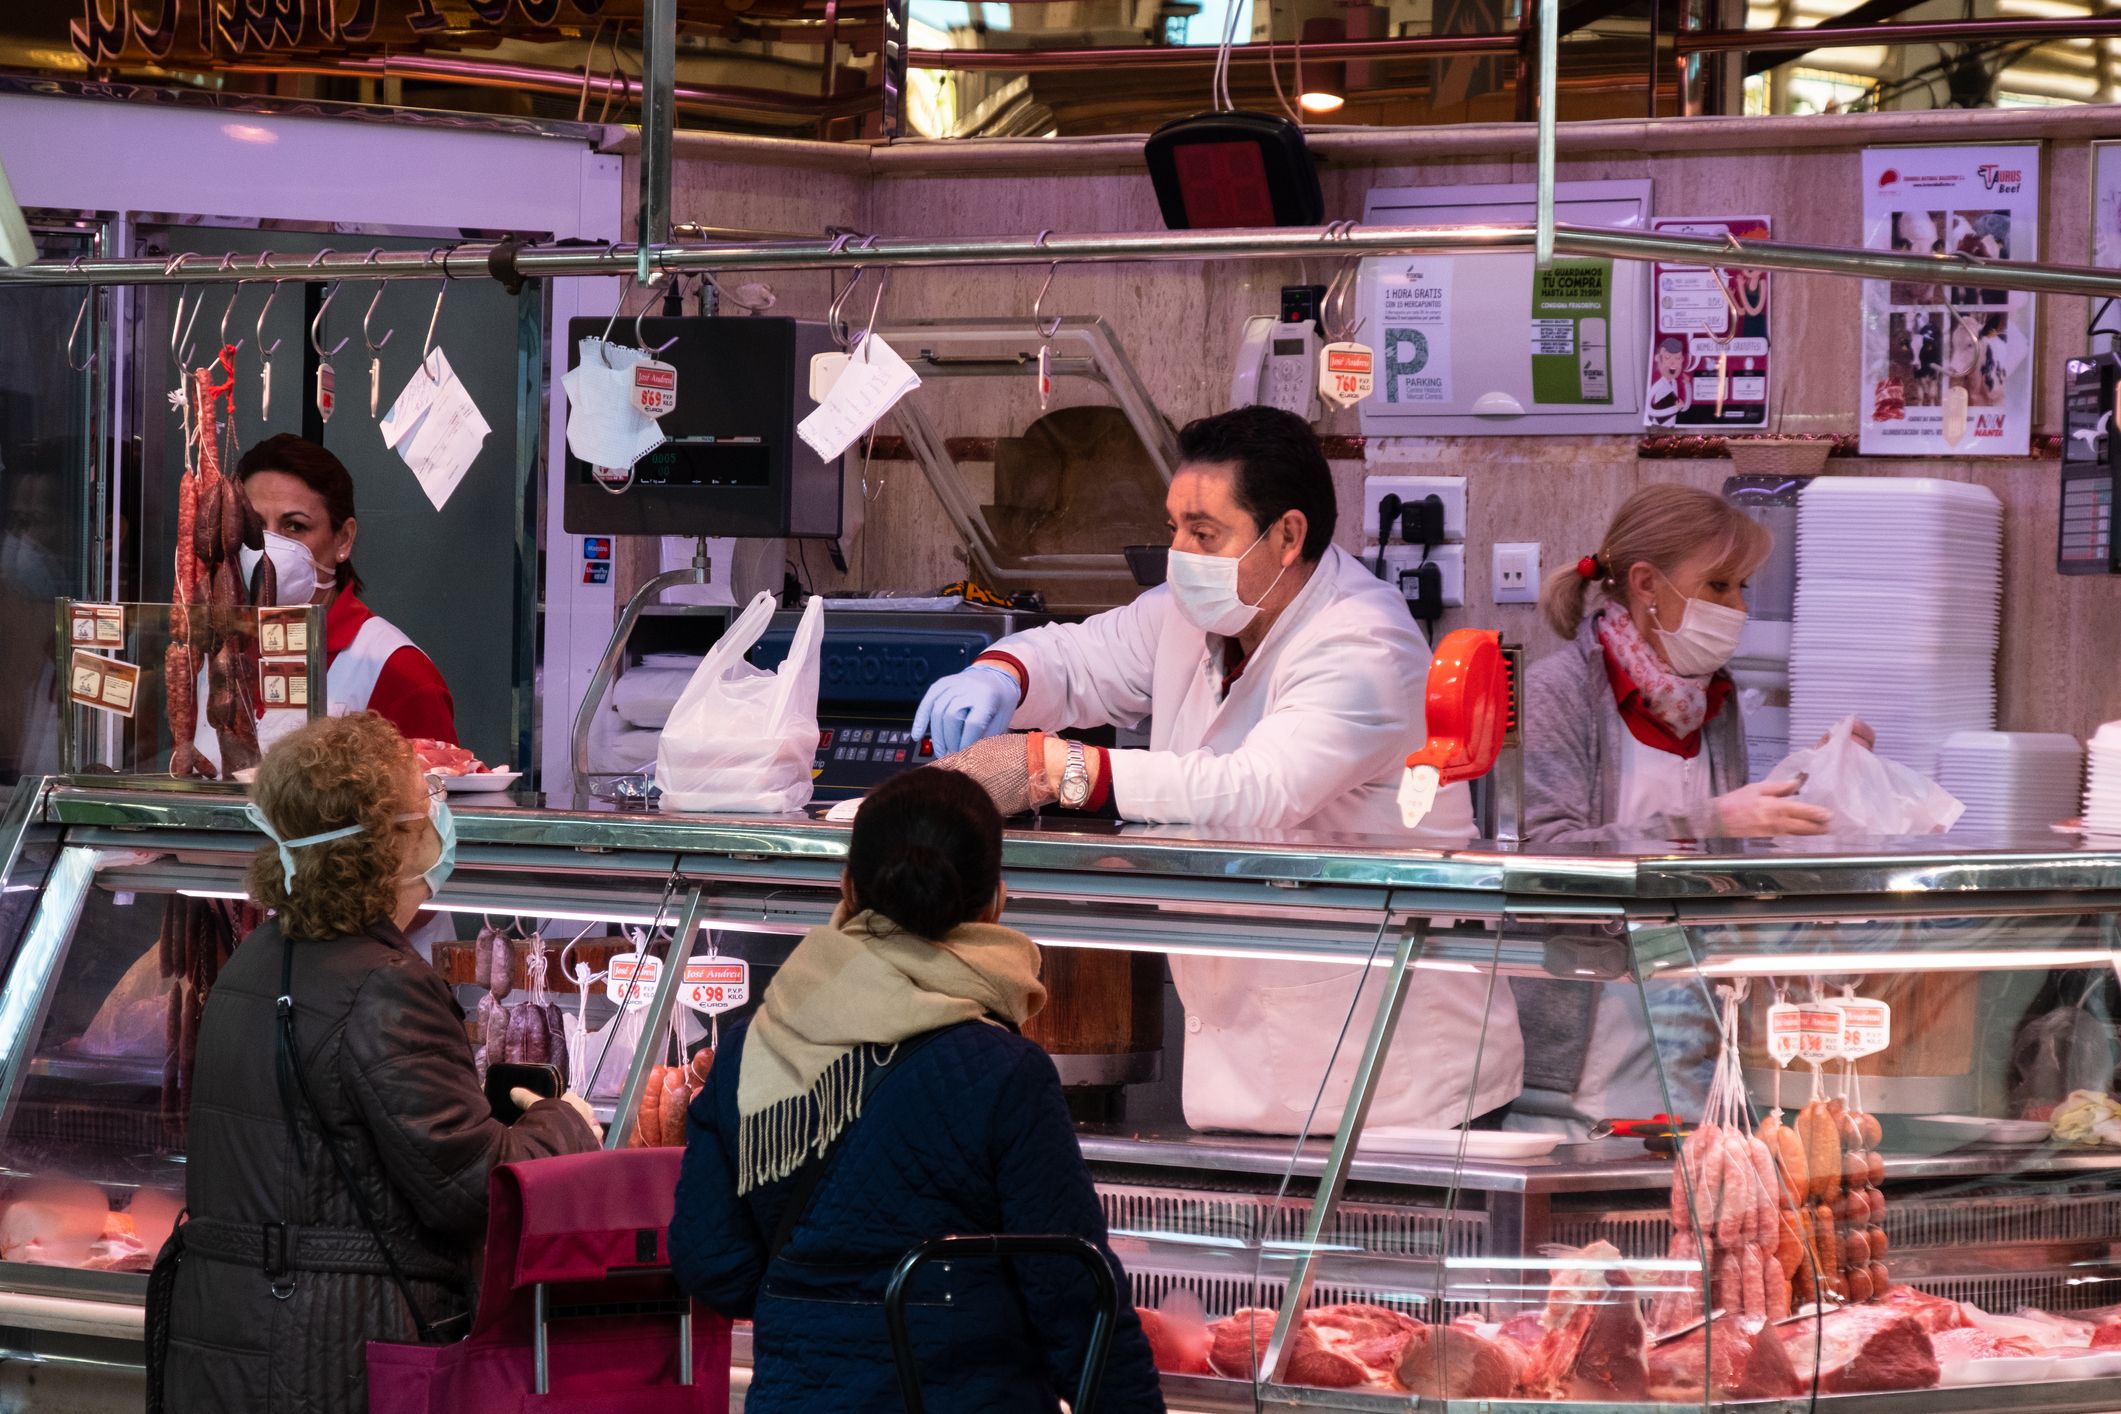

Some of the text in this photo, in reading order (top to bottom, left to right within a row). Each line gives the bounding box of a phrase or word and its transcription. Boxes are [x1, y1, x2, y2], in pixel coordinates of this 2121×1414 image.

[1999, 184, 2020, 193] Beef
[1554, 268, 1602, 276] GUARDAMOS
[1542, 277, 1602, 288] TU COMPRA
[1386, 288, 1442, 298] 1 HORA GRATIS
[1541, 289, 1564, 297] HASTA
[1566, 289, 1578, 297] LAS
[1346, 358, 1370, 368] Andreu
[1385, 328, 1429, 403] P
[638, 371, 673, 385] José Andreu
[1406, 378, 1442, 386] PARKING
[641, 390, 662, 406] 8'69
[614, 966, 656, 977] José Adreu
[686, 968, 740, 978] José Andreu
[692, 986, 724, 1002] 6'98
